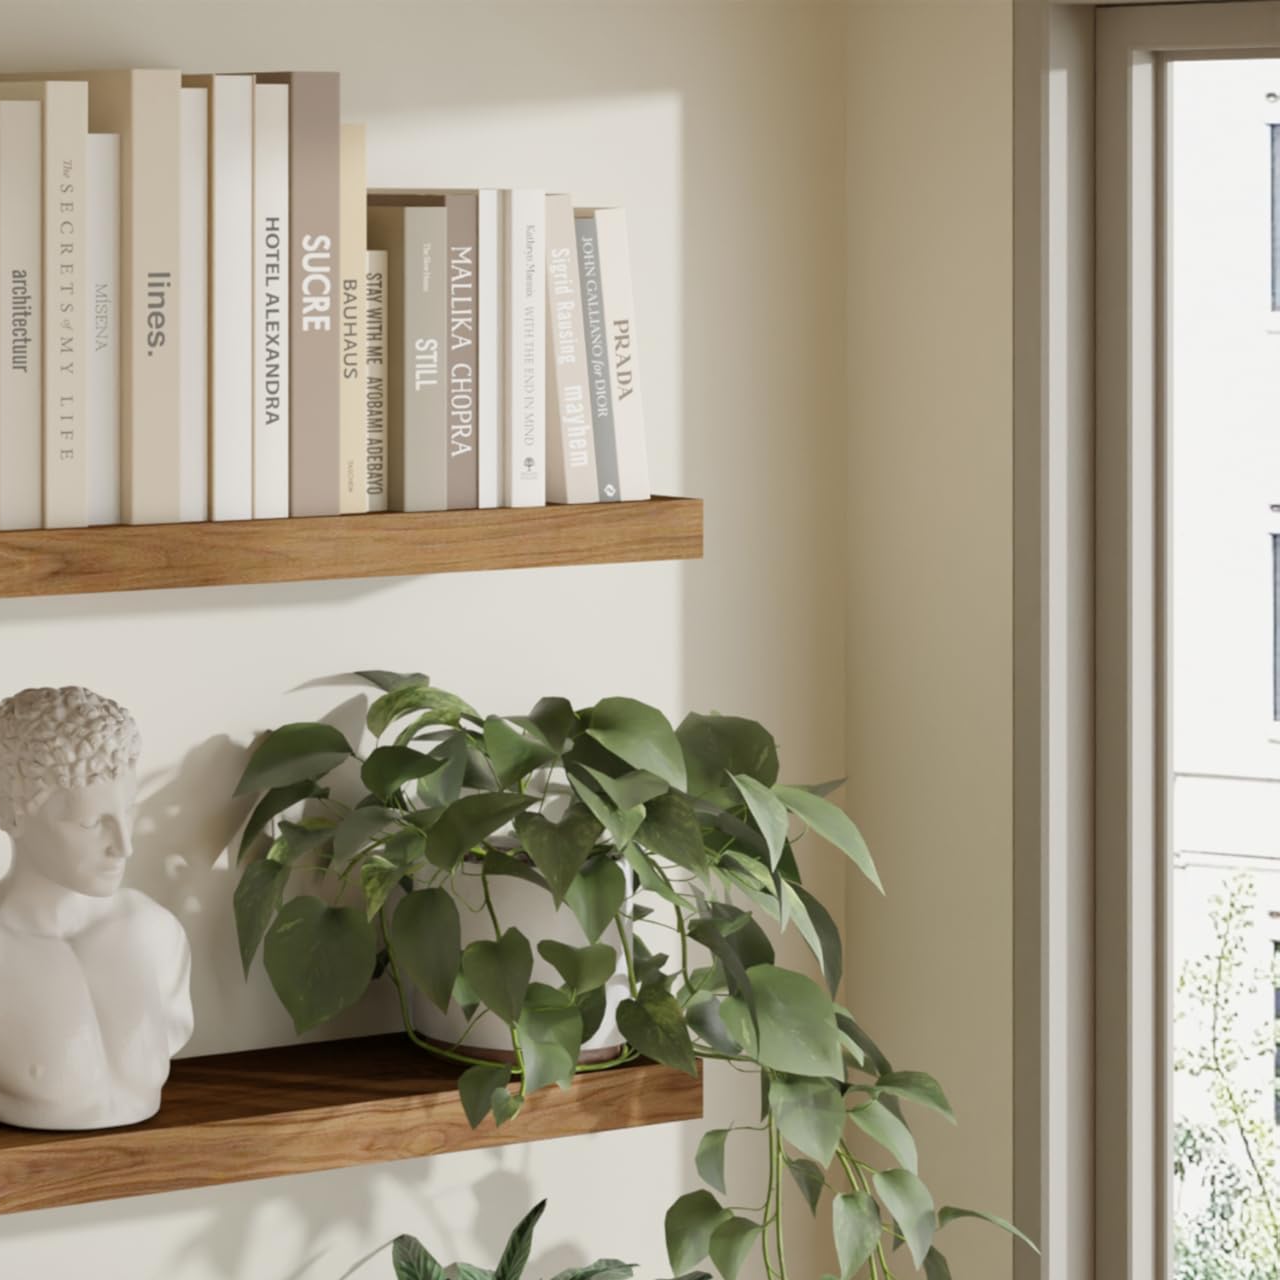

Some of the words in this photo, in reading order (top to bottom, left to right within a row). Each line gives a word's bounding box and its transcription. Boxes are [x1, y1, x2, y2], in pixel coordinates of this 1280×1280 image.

[62, 160, 72, 178] The
[60, 184, 73, 313] SECRETS
[265, 218, 279, 286] HOTEL
[549, 248, 573, 295] Sigrid
[582, 237, 594, 276] JOHN
[302, 234, 331, 331] SUCRE
[367, 273, 383, 306] STAY
[451, 246, 472, 350] MALLIKA
[12, 270, 31, 372] architectuur
[61, 320, 73, 331] of
[147, 272, 171, 357] lines.
[344, 279, 357, 379] BAUHAUS
[367, 308, 383, 341] WITH
[524, 306, 534, 339] WITH
[556, 302, 577, 365] Rausing
[585, 280, 602, 357] GALLIANO
[60, 337, 73, 375] MY
[265, 294, 279, 424] ALEXANDRA
[367, 346, 383, 365] ME
[415, 339, 437, 390] STILL
[524, 341, 534, 364] THE
[591, 360, 604, 376] for
[613, 319, 633, 400] PRADA
[367, 377, 383, 432] AYOBAMI
[524, 368, 534, 393] END
[524, 397, 534, 409] IN
[595, 380, 608, 417] DIOR
[60, 397, 73, 461] LIFE
[451, 363, 472, 457] CHOPRA
[524, 413, 534, 446] MIND
[561, 385, 591, 467] mayhem
[367, 438, 383, 494] ADEBAYO
